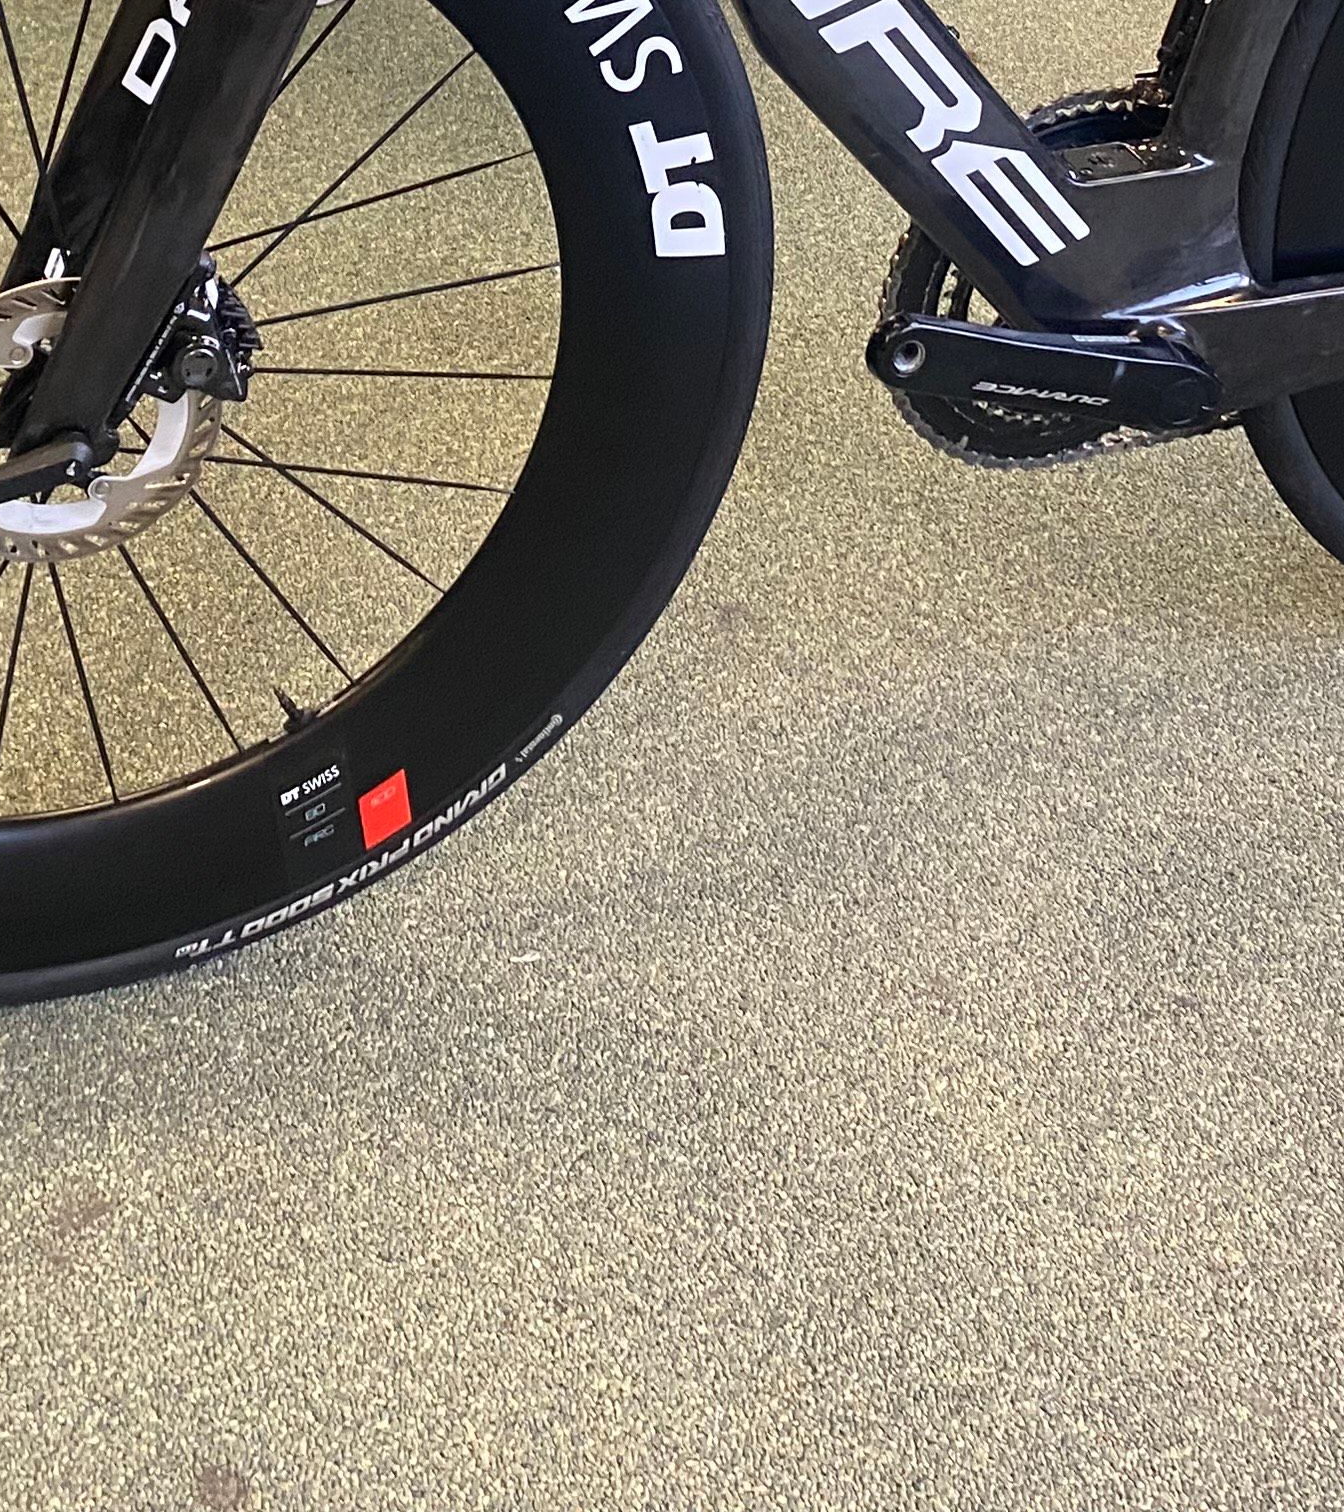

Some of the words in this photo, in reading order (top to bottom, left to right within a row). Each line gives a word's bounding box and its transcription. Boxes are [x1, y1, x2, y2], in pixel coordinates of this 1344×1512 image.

[629, 120, 726, 258] DT
[280, 786, 300, 806] DT
[302, 764, 340, 795] SWISS
[413, 762, 507, 847] GRAND
[337, 838, 411, 894] PRIX
[241, 883, 334, 939] 5000
